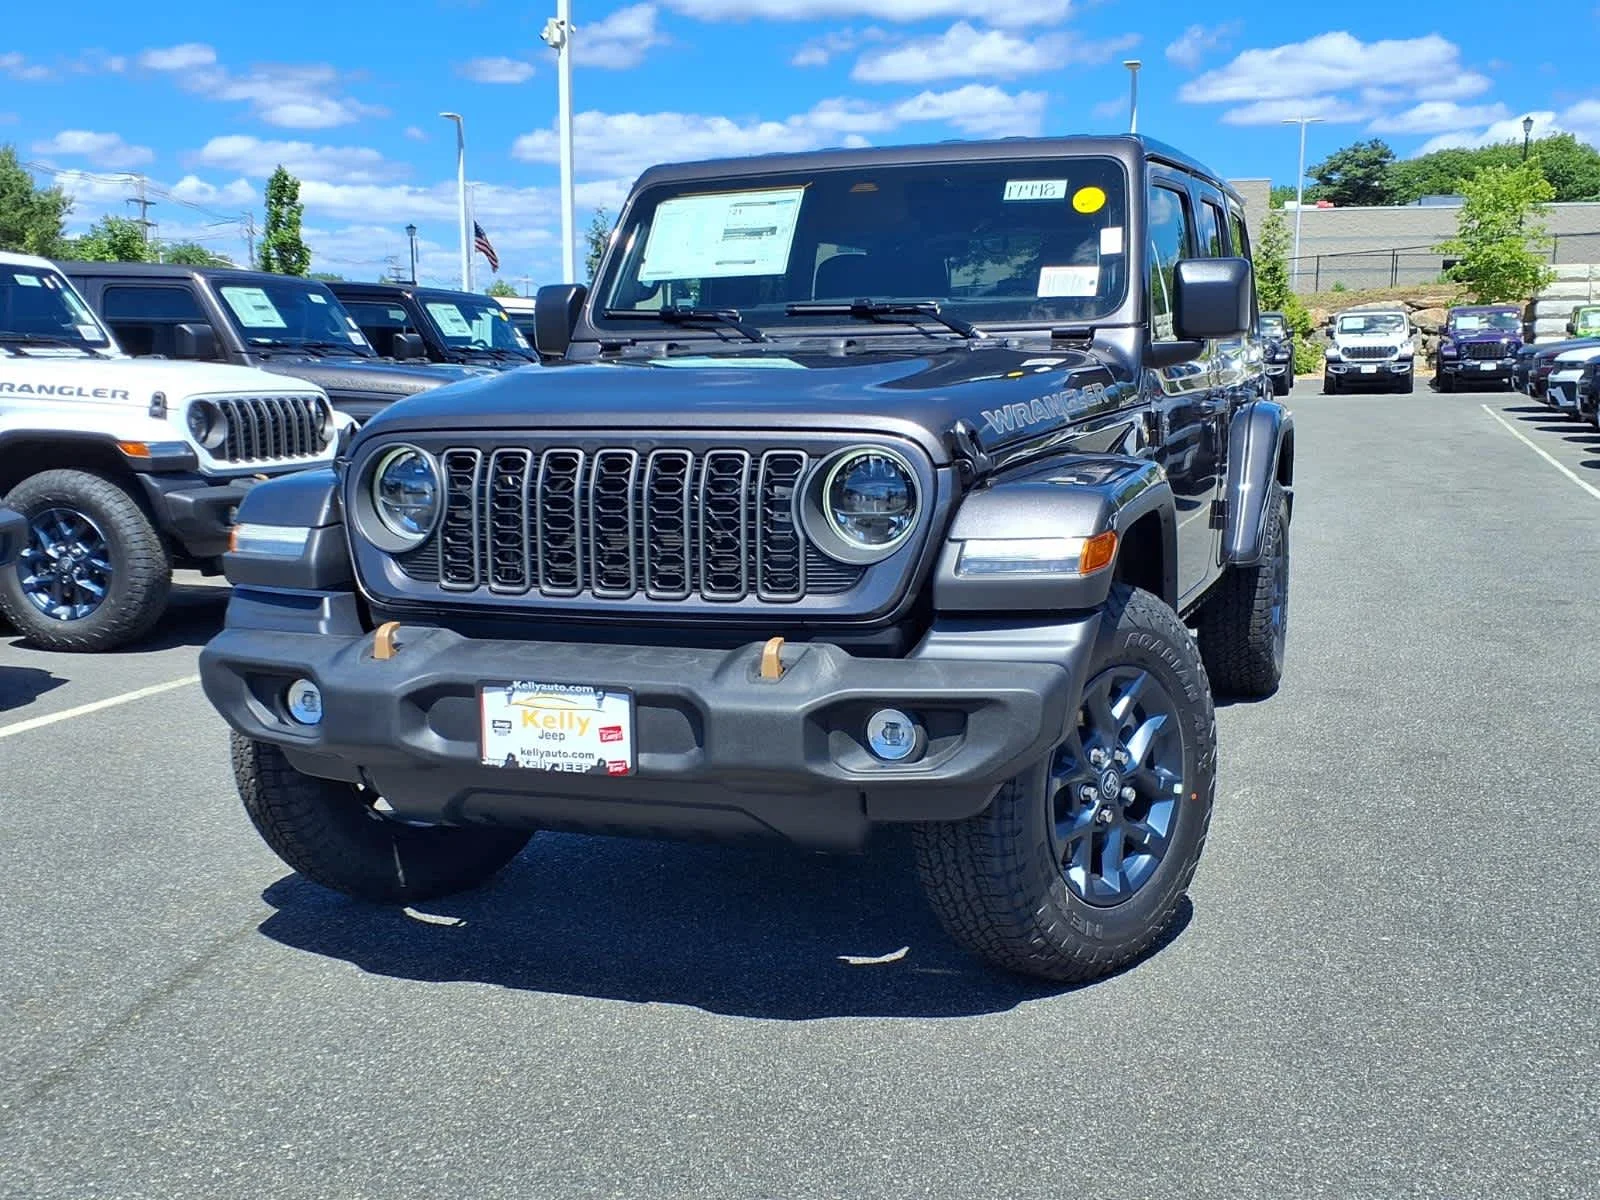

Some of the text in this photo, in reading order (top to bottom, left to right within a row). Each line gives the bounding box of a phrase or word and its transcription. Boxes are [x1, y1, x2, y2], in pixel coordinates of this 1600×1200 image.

[0, 382, 129, 400] RANGLER
[981, 383, 1109, 434] WRANGLER
[513, 681, 595, 693] Kellyauto.com
[521, 709, 591, 736] Kelly
[538, 728, 566, 742] Jeep
[520, 748, 595, 760] kellyauto.com
[554, 762, 592, 773] JEEP
